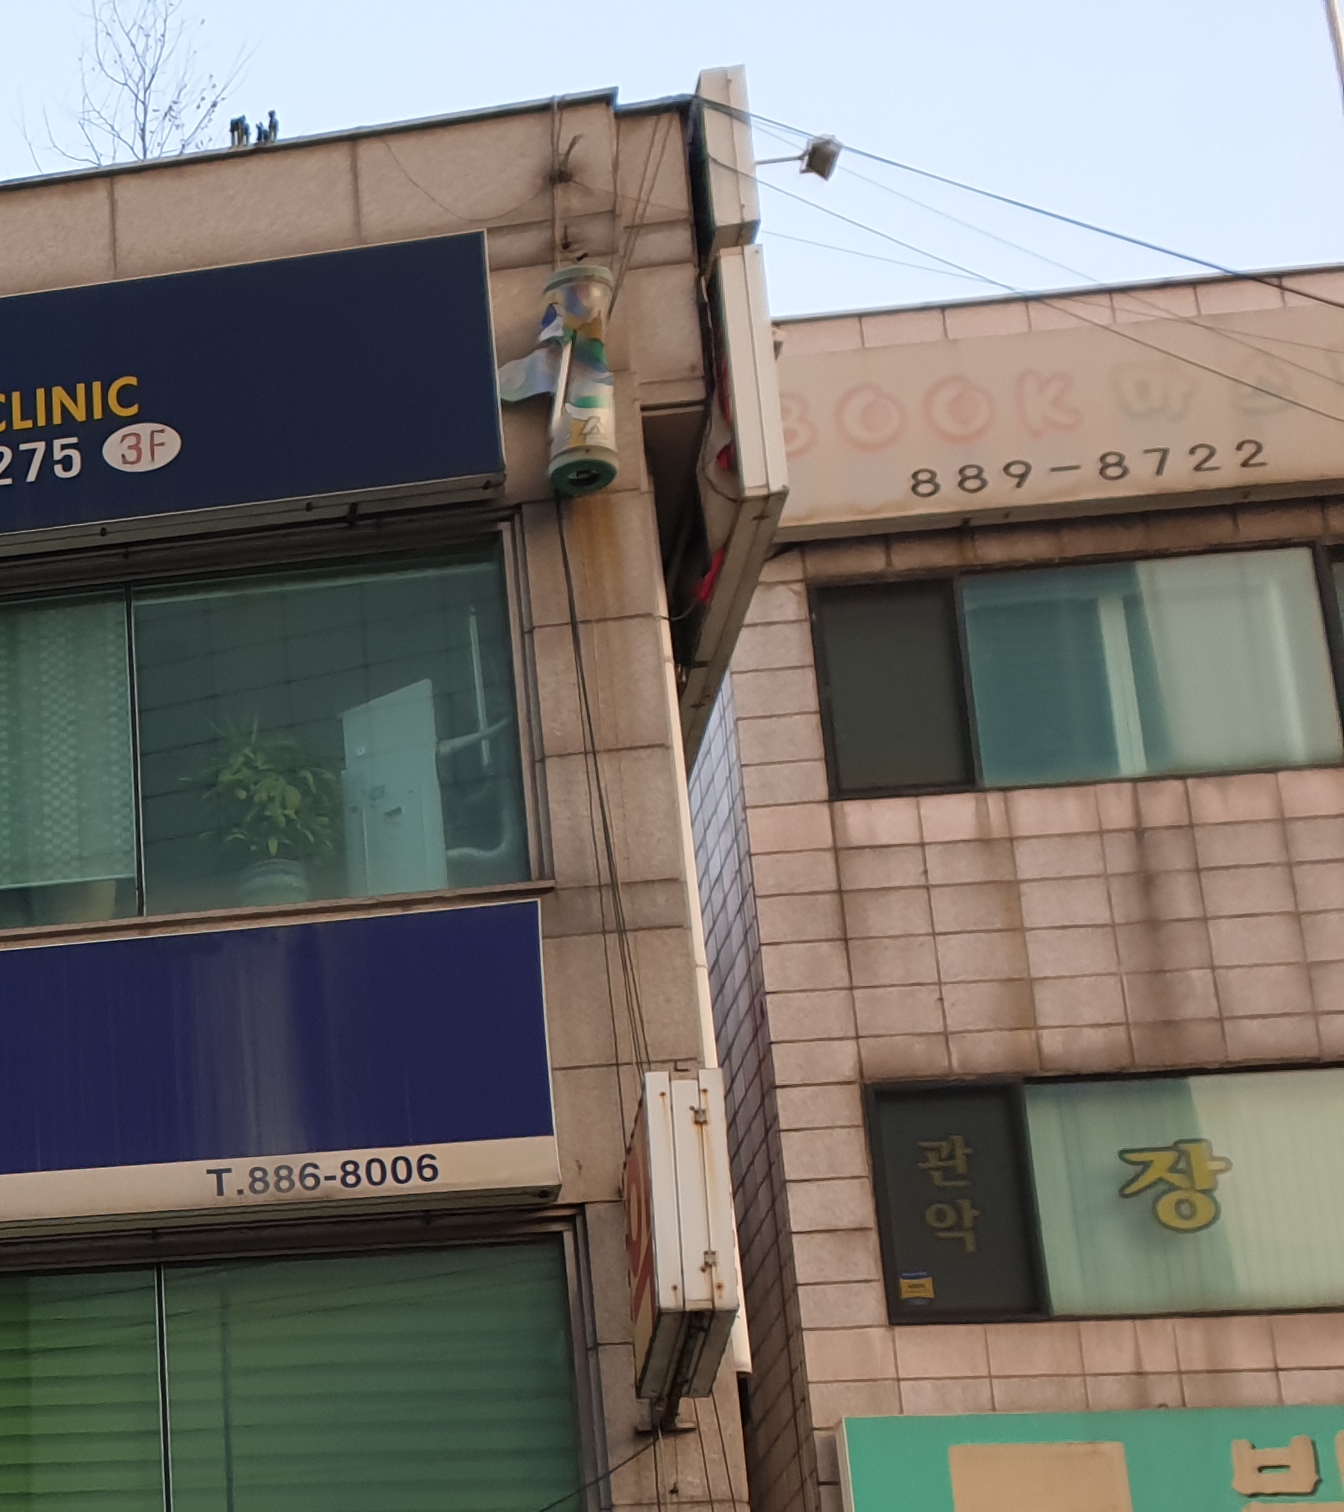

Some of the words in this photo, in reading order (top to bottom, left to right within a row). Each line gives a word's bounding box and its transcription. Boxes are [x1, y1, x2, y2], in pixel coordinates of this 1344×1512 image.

[119, 427, 166, 465] 3F
[910, 438, 1267, 499] 889-8722
[206, 1153, 439, 1198] T.886-8006
[917, 1134, 980, 1253] 관악
[1119, 1138, 1234, 1234] 장
